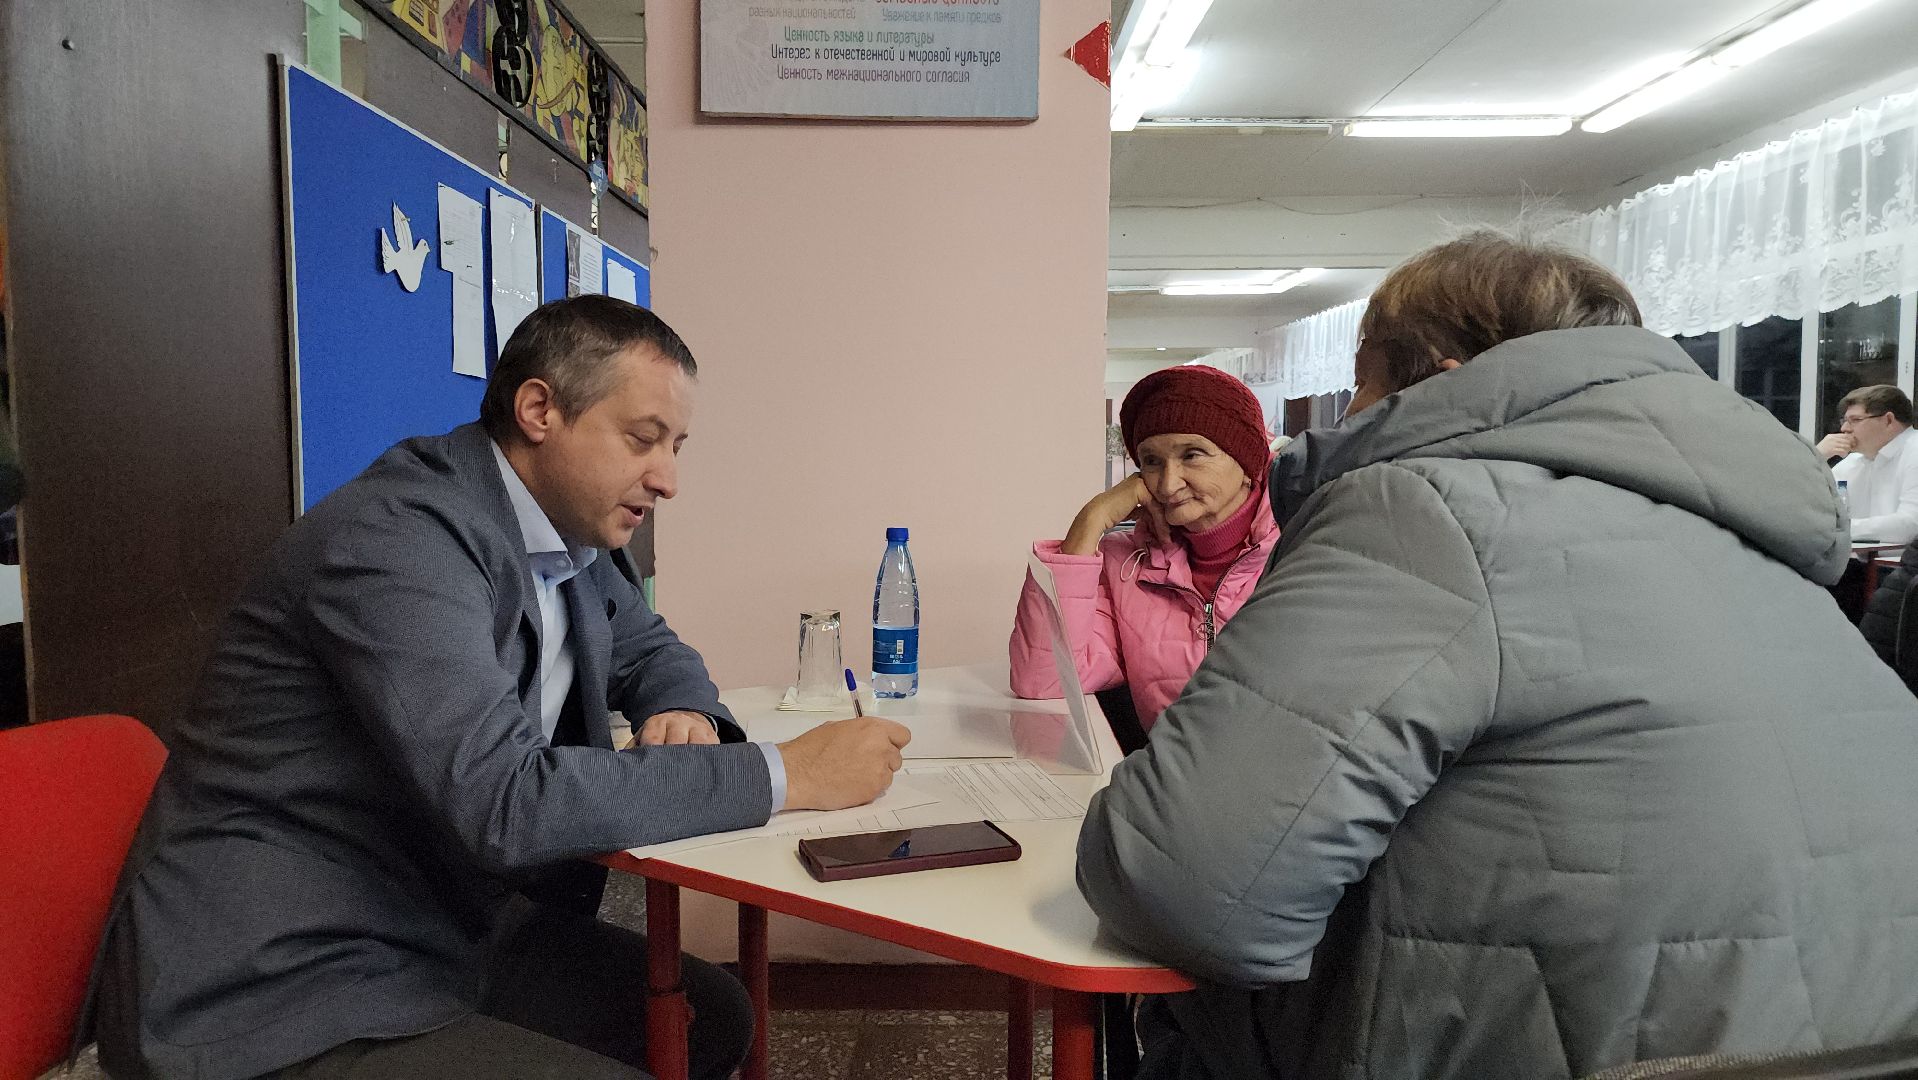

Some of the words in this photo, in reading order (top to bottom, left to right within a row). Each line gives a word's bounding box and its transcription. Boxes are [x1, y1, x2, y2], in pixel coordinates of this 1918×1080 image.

[784, 26, 830, 42] Ценность
[833, 30, 864, 42] языка
[867, 31, 873, 42] и
[876, 31, 935, 47] литературы
[771, 43, 811, 60] Интерес
[815, 48, 820, 59] к
[823, 46, 895, 60] отечественной
[900, 49, 905, 61] и
[908, 46, 951, 64] мировой
[954, 50, 1001, 66] культуре
[777, 64, 822, 81] Ценность
[826, 68, 922, 82] межнационального
[926, 70, 970, 83] согласия
